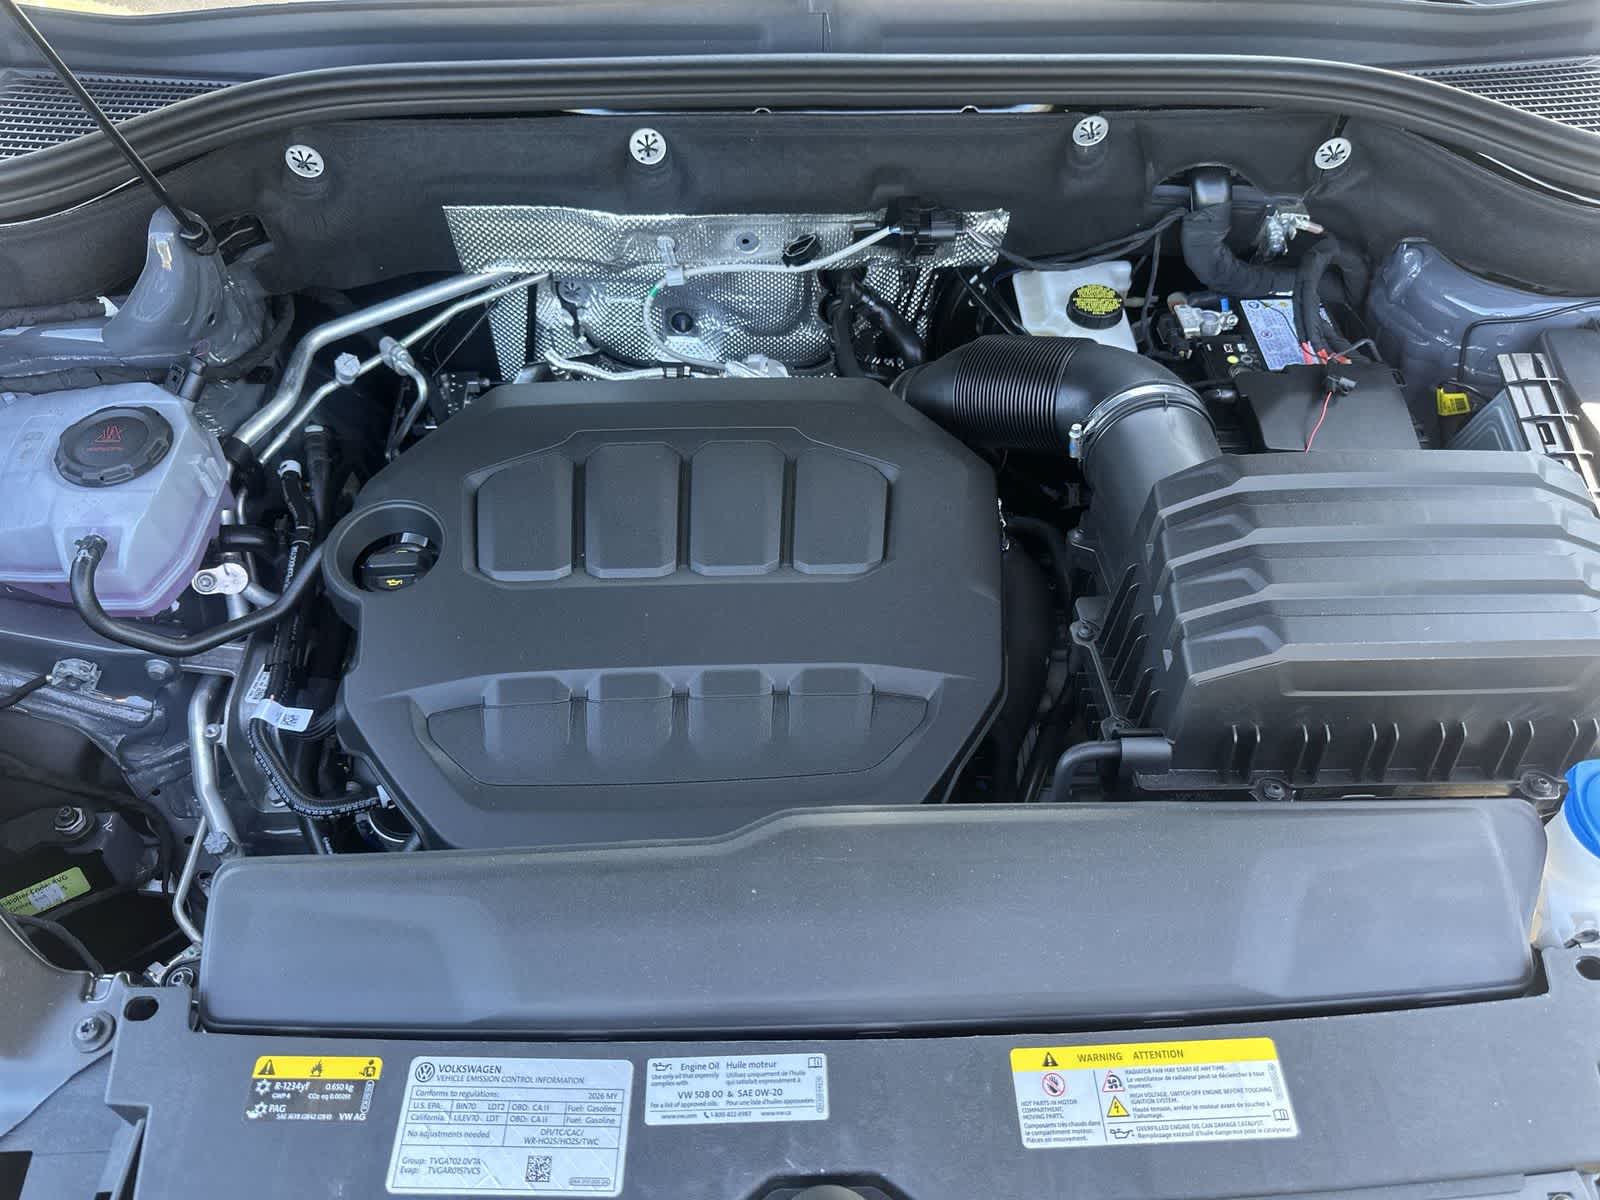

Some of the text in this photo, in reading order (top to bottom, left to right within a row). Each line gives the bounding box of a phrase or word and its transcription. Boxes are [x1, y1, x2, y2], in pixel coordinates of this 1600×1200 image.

[1077, 1049, 1184, 1063] WARNING ATTENTION
[438, 1064, 502, 1074] VOLKSWAGEN
[681, 1062, 720, 1072] Engine Oil
[726, 1061, 747, 1069] Huile
[466, 1075, 500, 1083] EMISSION
[501, 1076, 534, 1084] CONTROL
[536, 1076, 585, 1084] INFORMATION
[416, 1088, 448, 1097] Conforms
[588, 1092, 618, 1100] 2026 MY
[678, 1090, 694, 1099] VW
[694, 1090, 710, 1098] 508
[712, 1090, 724, 1098] 00
[737, 1089, 753, 1098] SAE
[754, 1088, 783, 1097] 0W-20
[269, 1104, 287, 1113] PAG
[487, 1102, 505, 1110] LDT2
[586, 1104, 616, 1112] Gasoline
[585, 1116, 616, 1124] Gasoline
[419, 1130, 462, 1139] adjustments
[464, 1130, 490, 1138] needed
